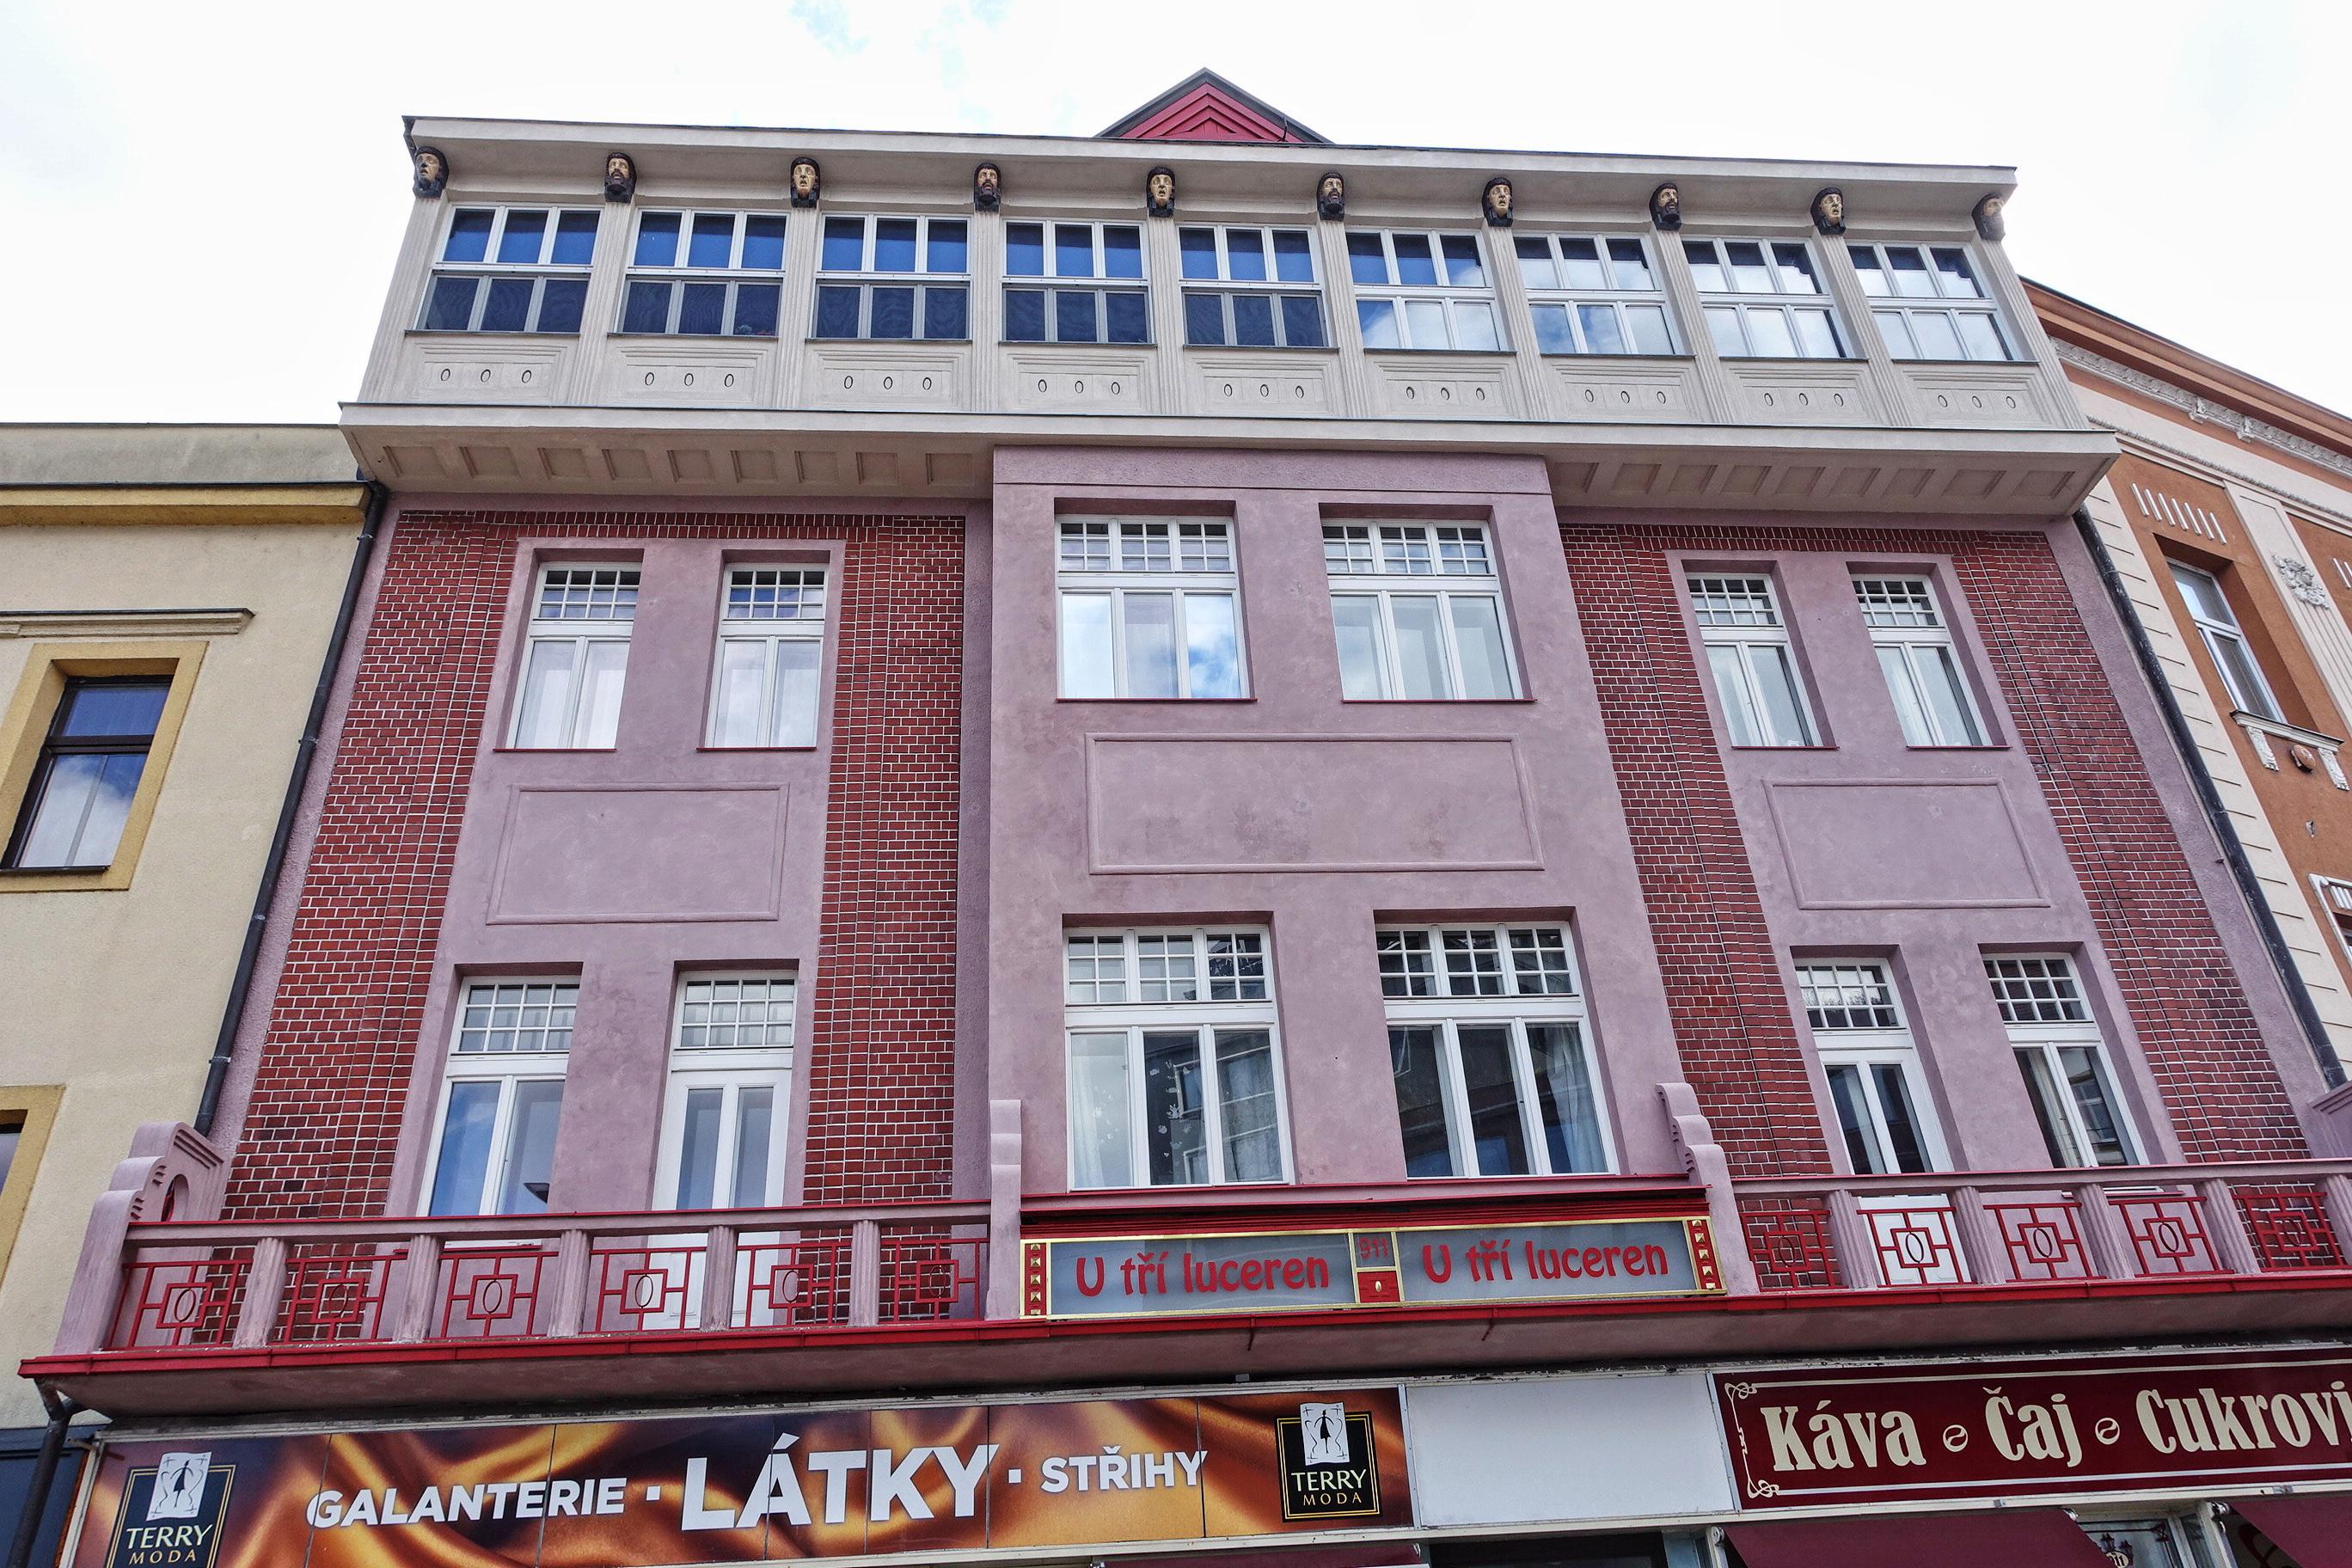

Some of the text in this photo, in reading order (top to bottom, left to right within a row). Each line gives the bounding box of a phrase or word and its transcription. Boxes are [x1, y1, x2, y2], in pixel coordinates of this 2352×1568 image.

[1076, 1251, 1331, 1297] U tří luceren
[1422, 1239, 1669, 1283] U tří luceren
[1760, 1400, 1927, 1472] Káva
[1982, 1387, 2083, 1467] Čaj
[306, 1432, 1208, 1531] GALANTERIE LÁTKY STŘIHY
[1290, 1468, 1367, 1491] TERRY
[1302, 1491, 1362, 1506] MODA
[126, 1524, 213, 1549] TERRY
[129, 1549, 196, 1565] MODA
